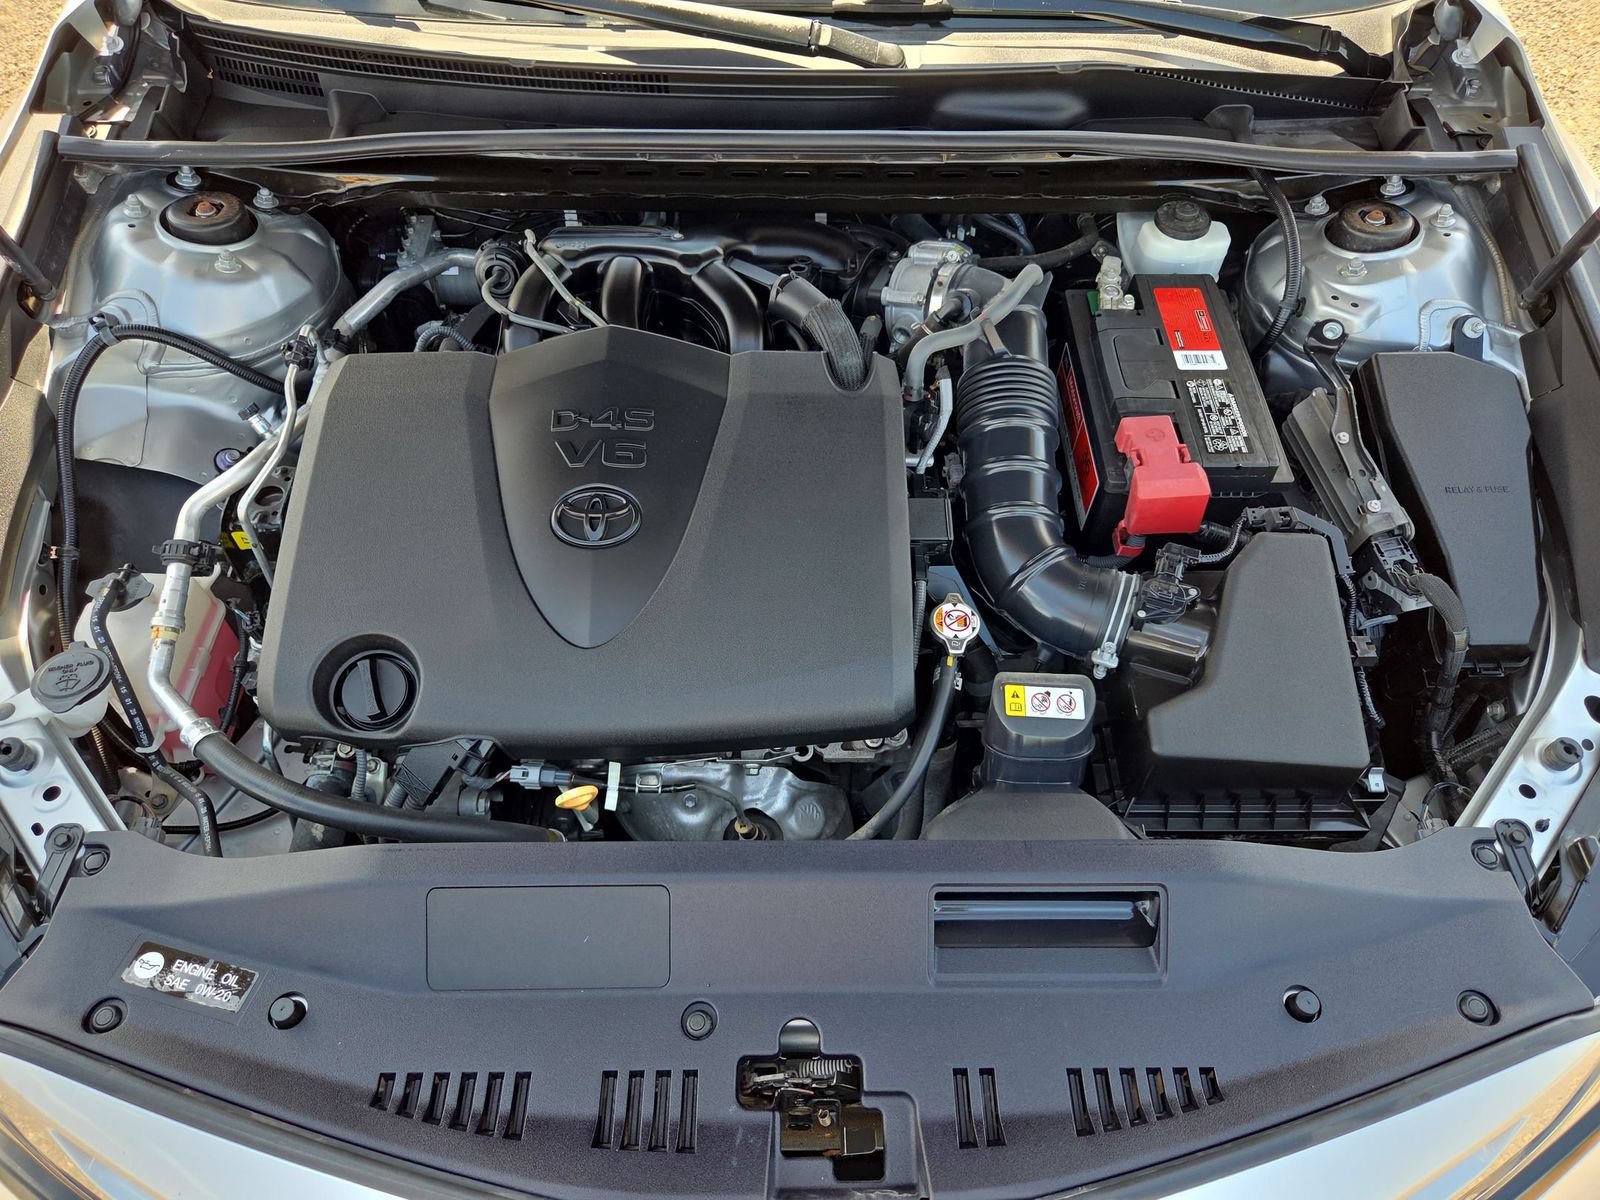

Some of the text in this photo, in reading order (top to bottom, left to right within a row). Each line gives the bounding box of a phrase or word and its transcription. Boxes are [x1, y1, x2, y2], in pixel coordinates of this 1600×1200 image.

[550, 406, 655, 432] D-4S
[554, 438, 648, 469] V6
[1444, 485, 1475, 494] RELAY
[1484, 485, 1511, 494] FUSE
[171, 959, 240, 988] ENGINE OIL
[163, 974, 233, 1003] SAE 0W-20
